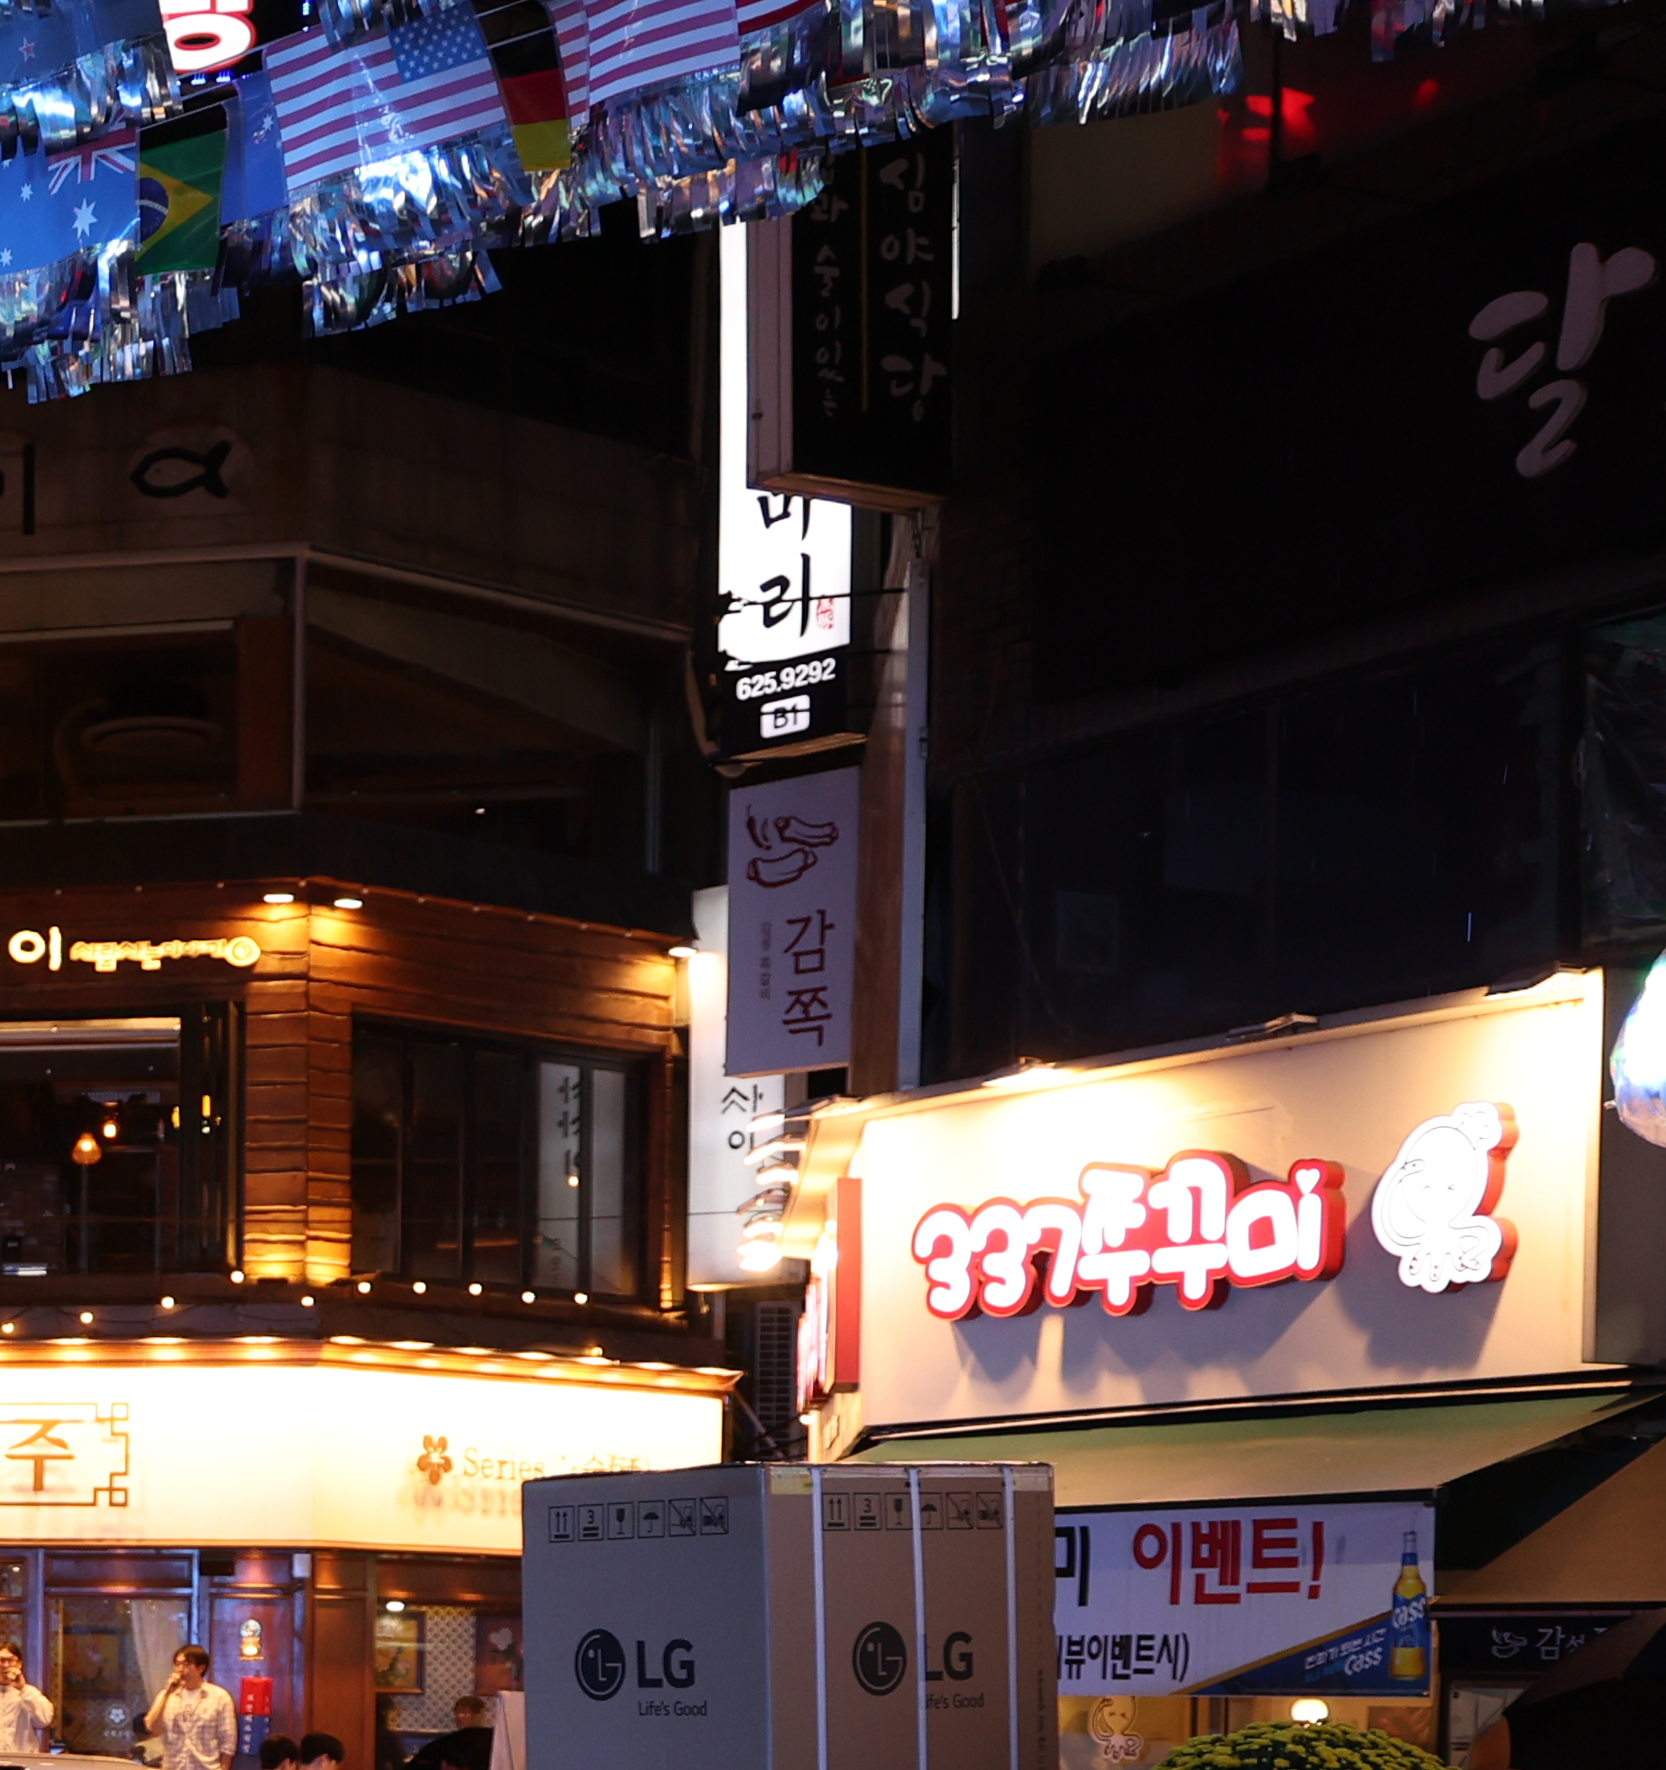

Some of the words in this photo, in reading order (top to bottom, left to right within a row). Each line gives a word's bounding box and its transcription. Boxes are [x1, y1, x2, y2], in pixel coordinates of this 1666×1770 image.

[1468, 242, 1658, 479] 달
[736, 658, 837, 700] 625.9292
[782, 908, 837, 1047] 감쪽
[1132, 1517, 1325, 1605] 이벤트!
[636, 1637, 696, 1689] LG
[638, 1701, 671, 1717] Life's
[673, 1701, 708, 1717] Good
[925, 1694, 952, 1710] ife's
[954, 1692, 985, 1709] Good
